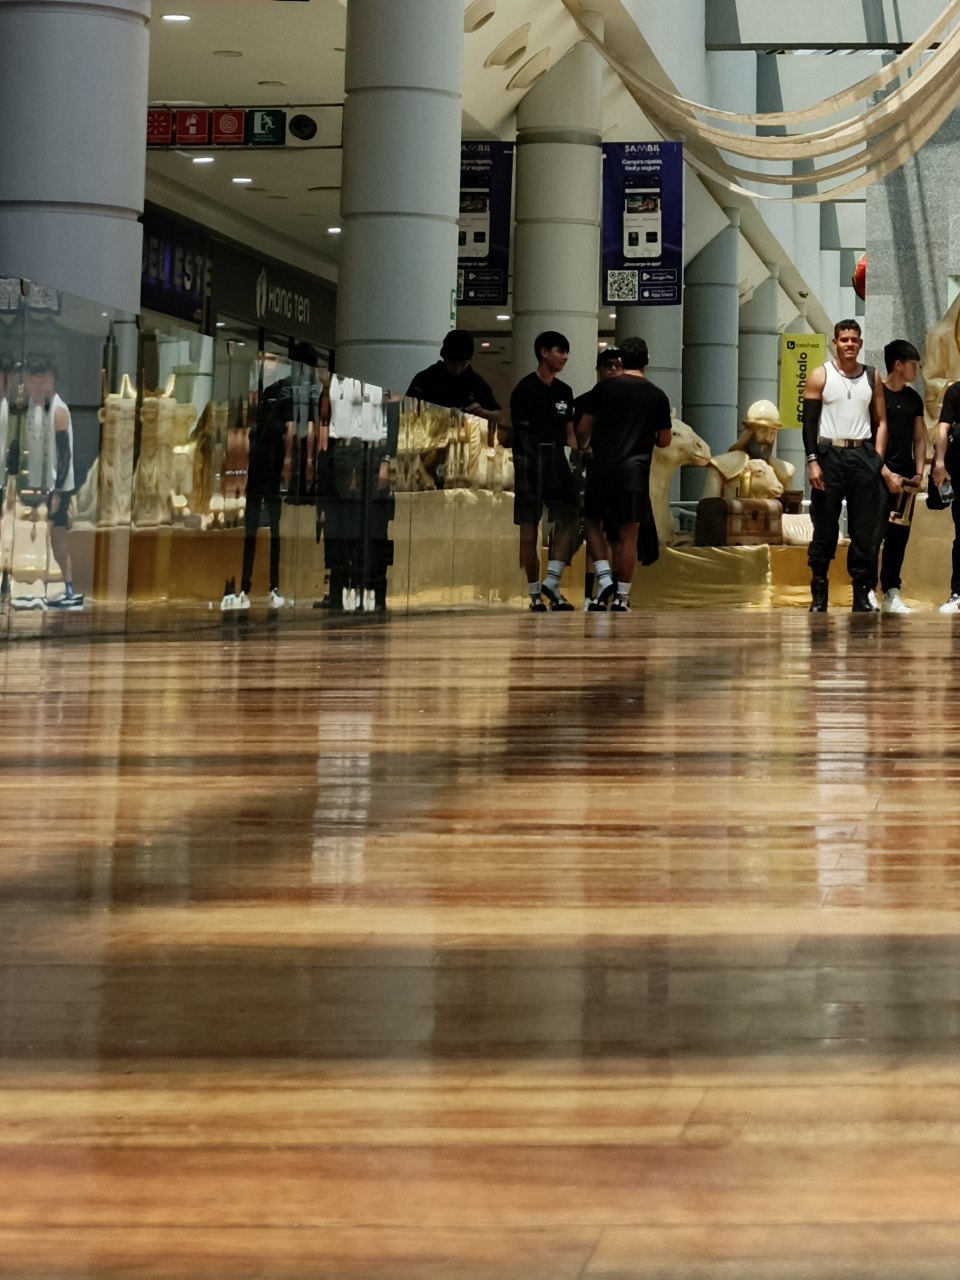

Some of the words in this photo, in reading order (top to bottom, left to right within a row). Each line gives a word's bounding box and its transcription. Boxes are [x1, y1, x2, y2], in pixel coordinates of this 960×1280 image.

[461, 144, 490, 152] AMBIL
[625, 144, 660, 152] SAMBIL
[796, 352, 808, 423] #Cashéalo
